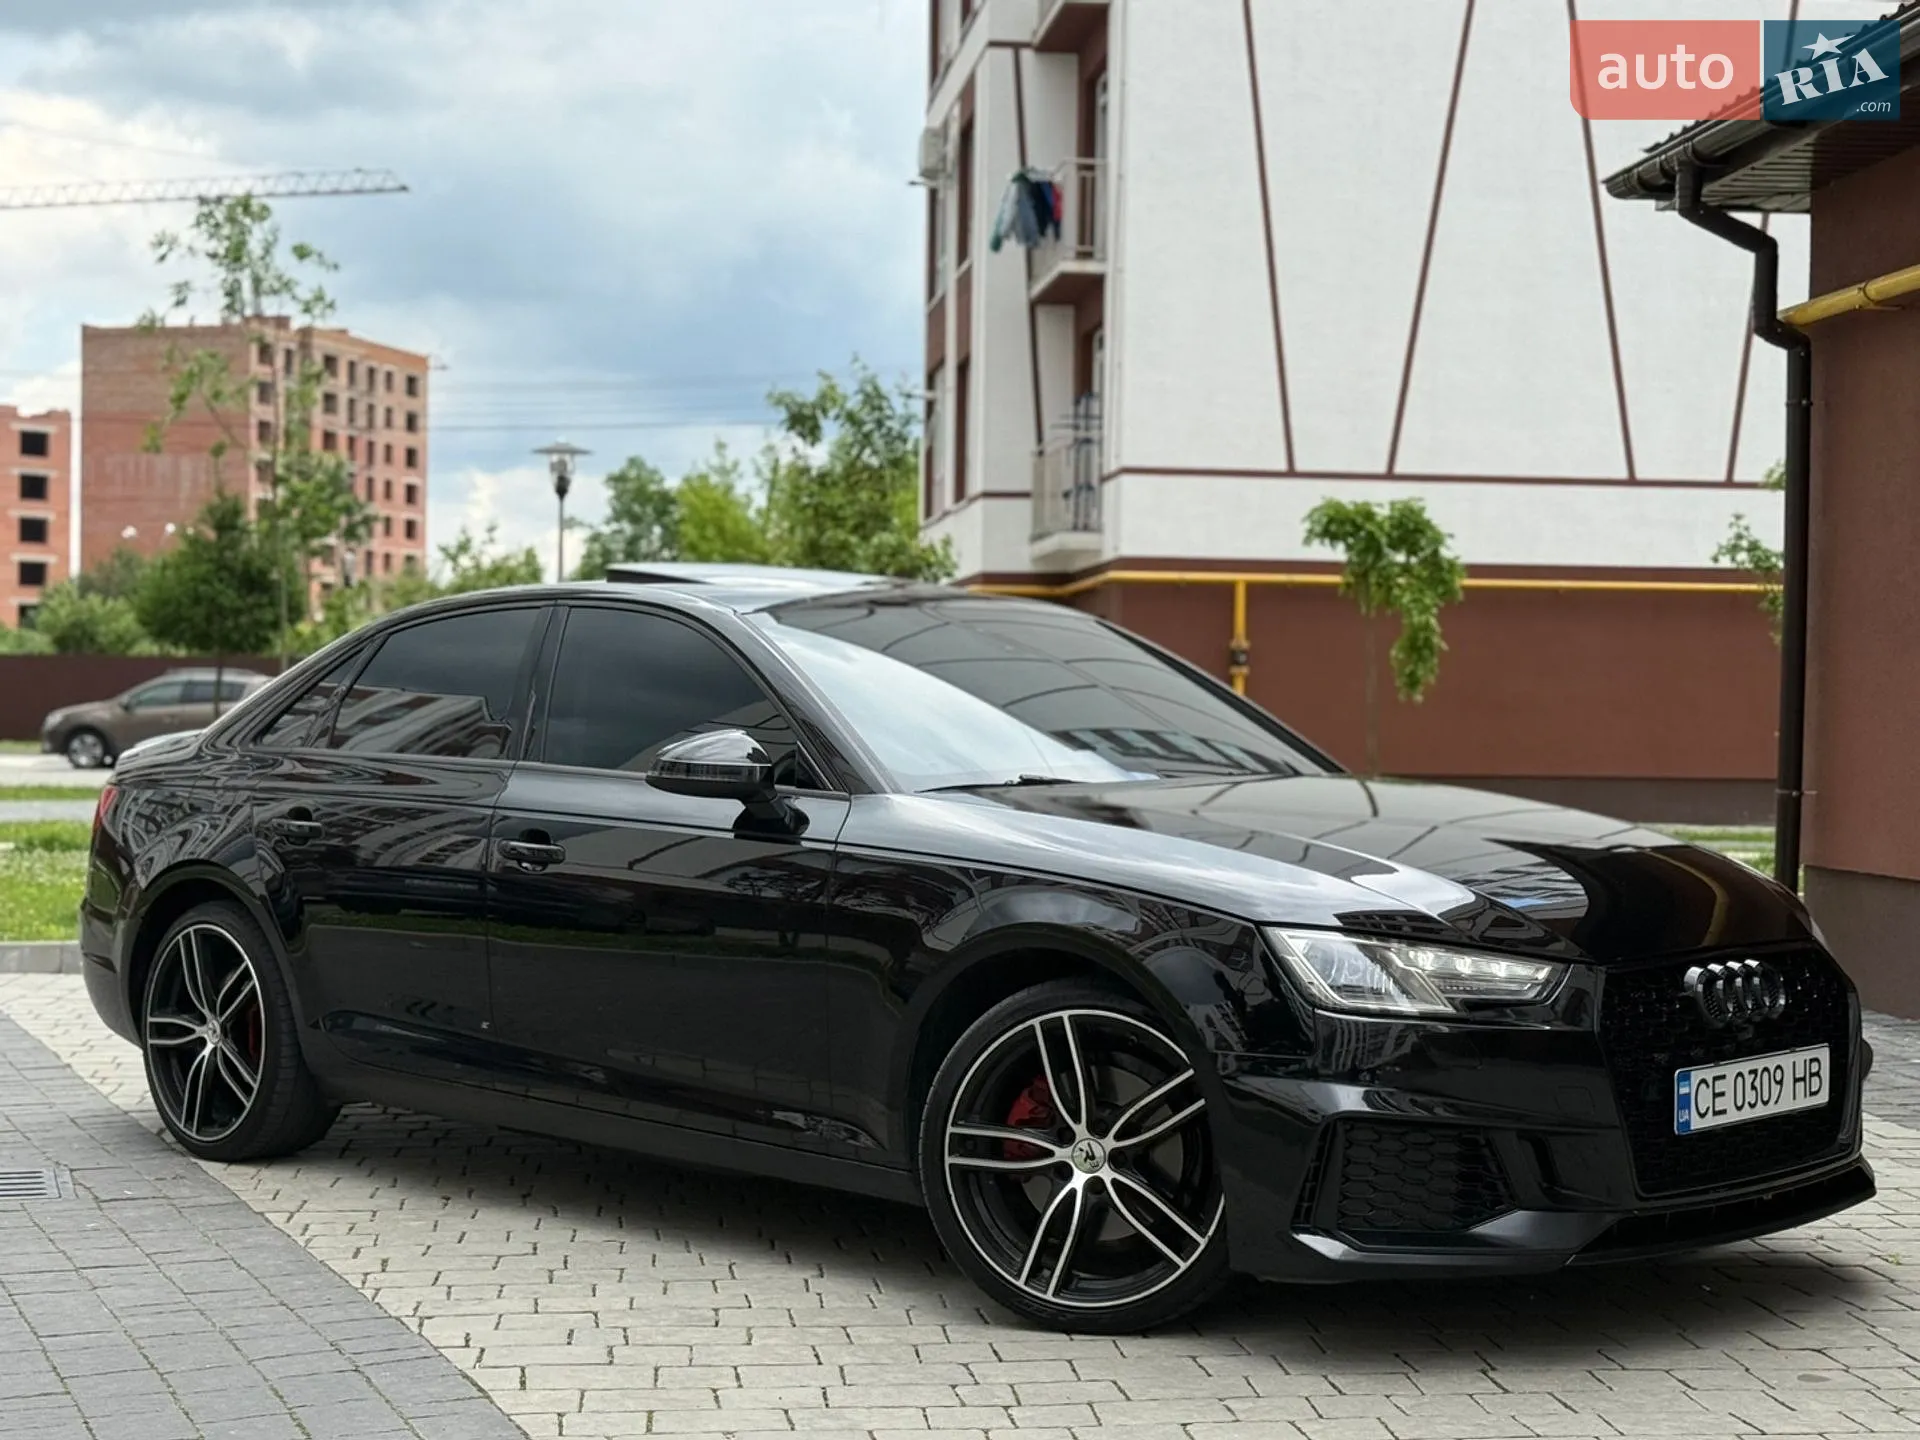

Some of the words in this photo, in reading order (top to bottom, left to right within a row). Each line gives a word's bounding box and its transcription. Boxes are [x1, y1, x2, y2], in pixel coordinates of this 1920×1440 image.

[1694, 1073, 1728, 1119] CE
[1733, 1064, 1785, 1112] 0309
[1791, 1057, 1823, 1101] HB
[1678, 1109, 1690, 1122] UA
